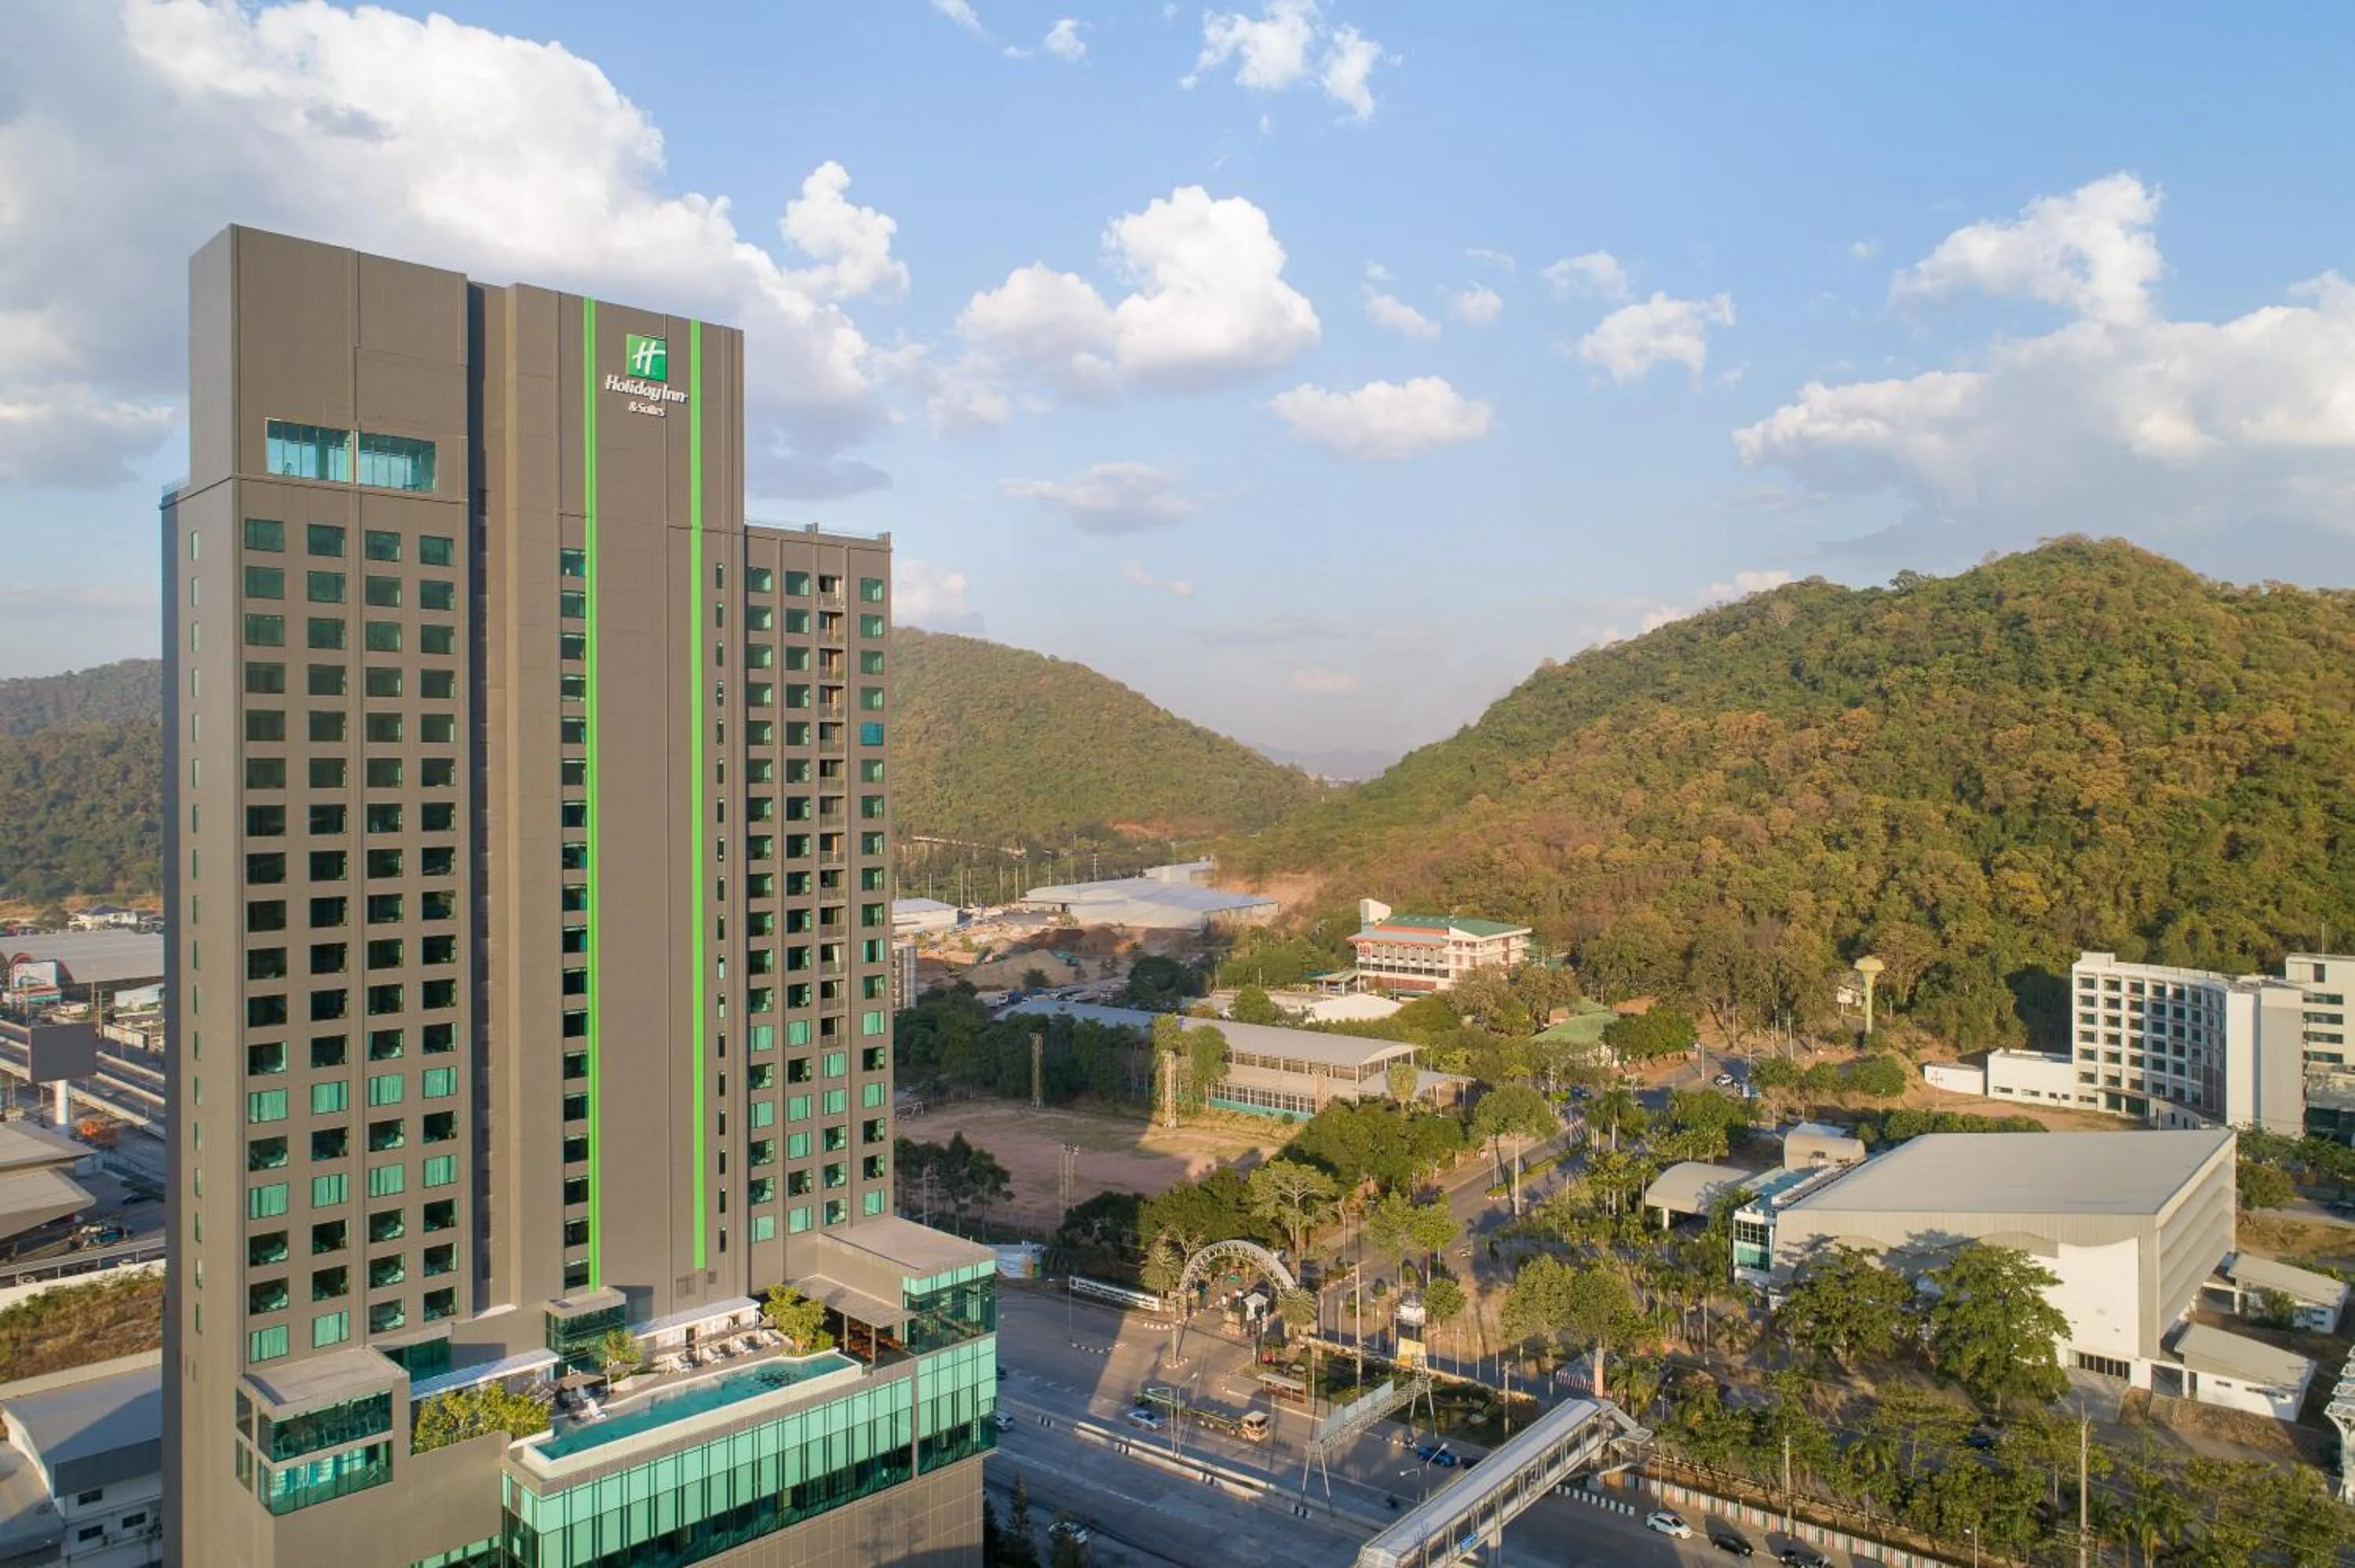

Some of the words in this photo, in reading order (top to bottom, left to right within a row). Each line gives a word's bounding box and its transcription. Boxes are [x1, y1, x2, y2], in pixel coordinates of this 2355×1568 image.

[604, 374, 661, 401] Holiday
[662, 383, 688, 403] Inn
[628, 401, 638, 412] &
